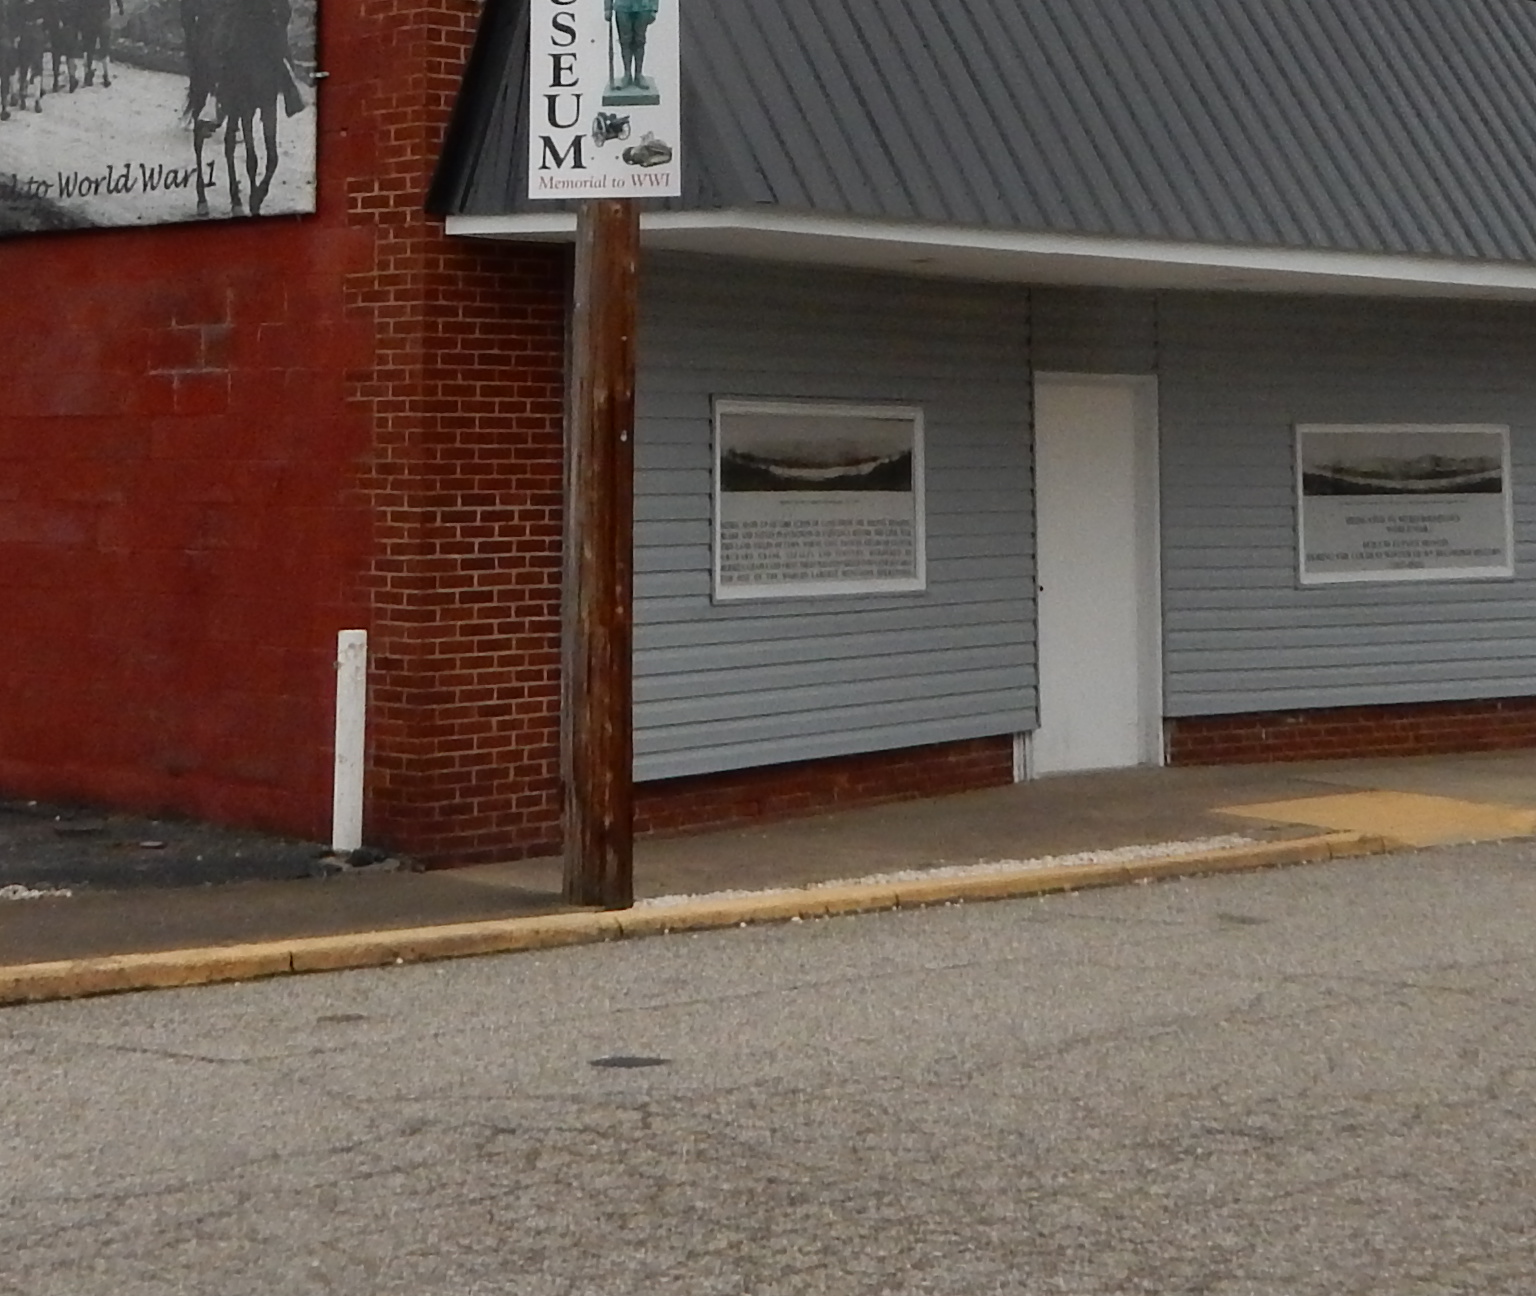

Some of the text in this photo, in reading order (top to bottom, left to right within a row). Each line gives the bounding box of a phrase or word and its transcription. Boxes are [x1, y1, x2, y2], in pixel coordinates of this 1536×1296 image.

[26, 176, 53, 199] to
[58, 162, 138, 198] World
[139, 162, 197, 193] War
[538, 173, 670, 190] Memorial to WWI
